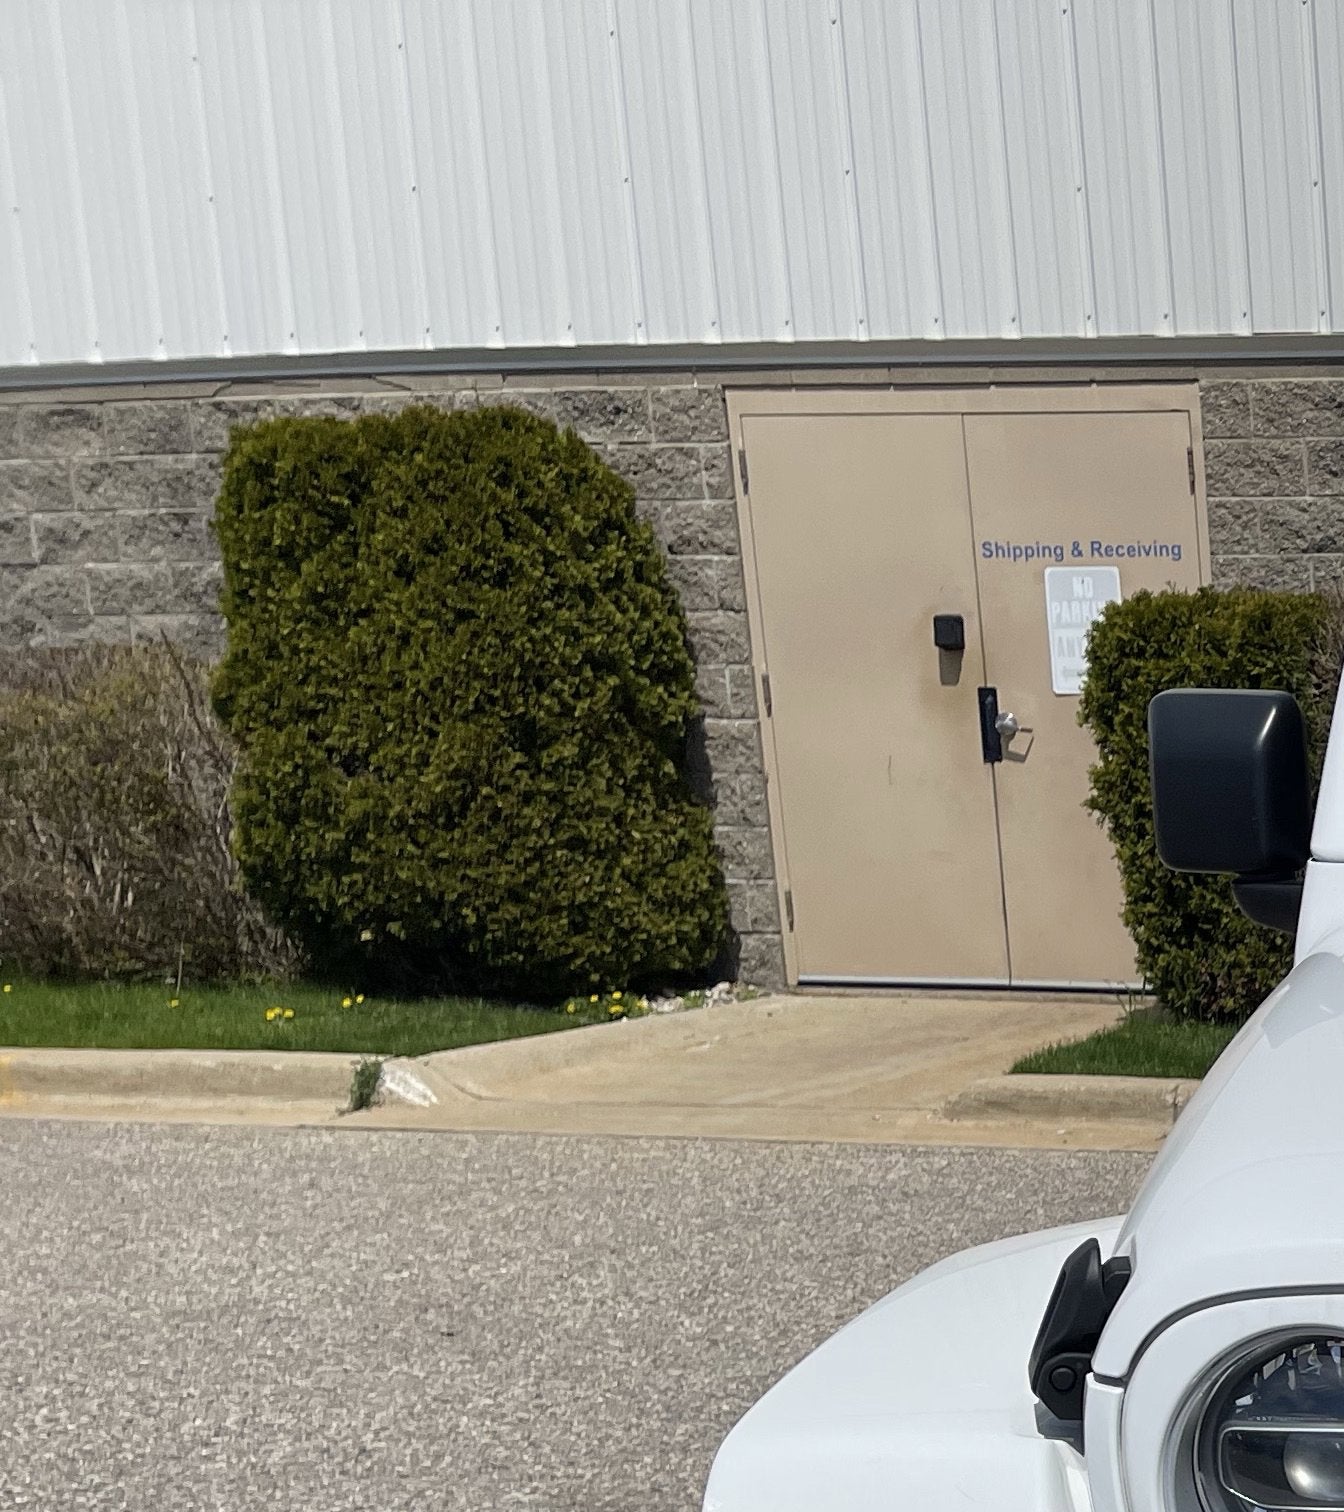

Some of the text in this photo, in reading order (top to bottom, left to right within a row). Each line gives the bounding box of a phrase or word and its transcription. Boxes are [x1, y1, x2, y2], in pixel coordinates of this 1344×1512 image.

[981, 540, 1183, 562] Shipping & Receiving
[1072, 576, 1094, 598] NO
